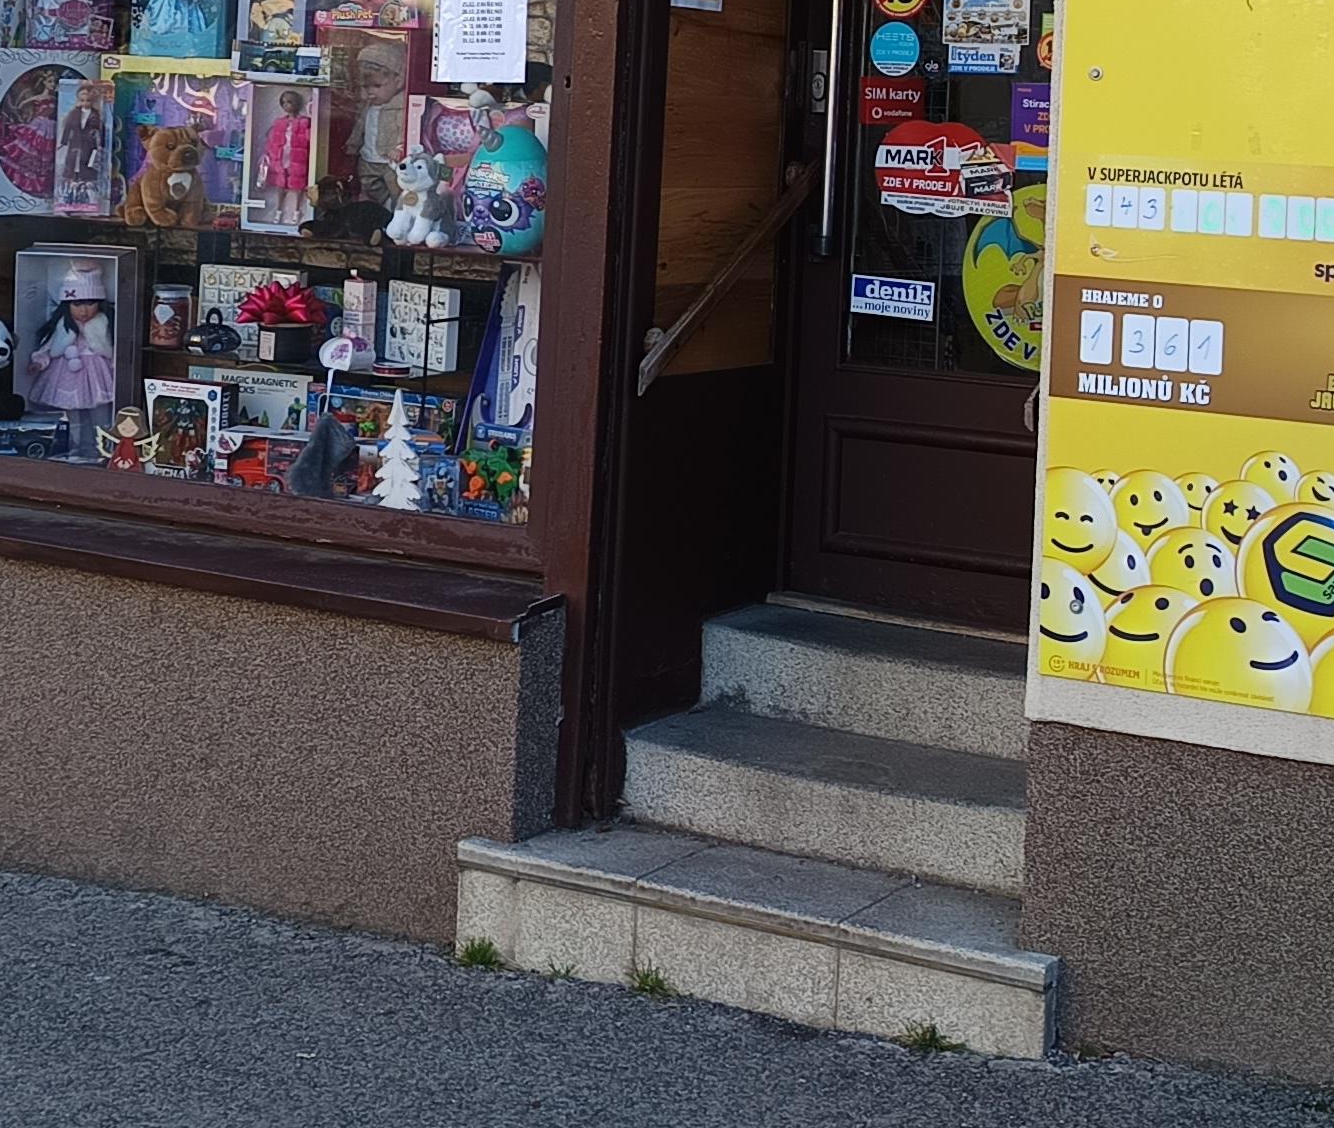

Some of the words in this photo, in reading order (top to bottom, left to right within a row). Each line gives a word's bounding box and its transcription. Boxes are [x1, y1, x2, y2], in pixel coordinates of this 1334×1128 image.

[331, 9, 356, 20] Plush
[357, 9, 373, 19] Pet
[876, 32, 915, 42] HEETS
[957, 50, 995, 63] týden
[864, 87, 887, 100] SIM
[889, 87, 921, 103] karty
[1022, 98, 1051, 108] Stírac
[883, 109, 913, 117] vodafone
[1023, 123, 1031, 133] V
[883, 176, 903, 187] ZDE
[903, 178, 912, 189] V
[1087, 166, 1098, 181] V
[1100, 167, 1209, 187] SUPERJACKPOTU
[1212, 172, 1244, 190] LÉTÁ
[969, 206, 1009, 216] RAKOVINU
[865, 279, 931, 305] deník
[1082, 288, 1149, 308] HRAJEME
[1153, 294, 1164, 310] O
[893, 305, 931, 319] noviny
[985, 308, 1022, 352] ZDE
[1023, 342, 1038, 361] V
[221, 374, 250, 385] MAGIC
[252, 378, 299, 389] MAGNETIC
[1077, 372, 1173, 402] MILIONŮ
[1179, 379, 1212, 406] KČ
[1067, 660, 1091, 672] HRAJ
[1100, 666, 1140, 679] ROZUMEM
